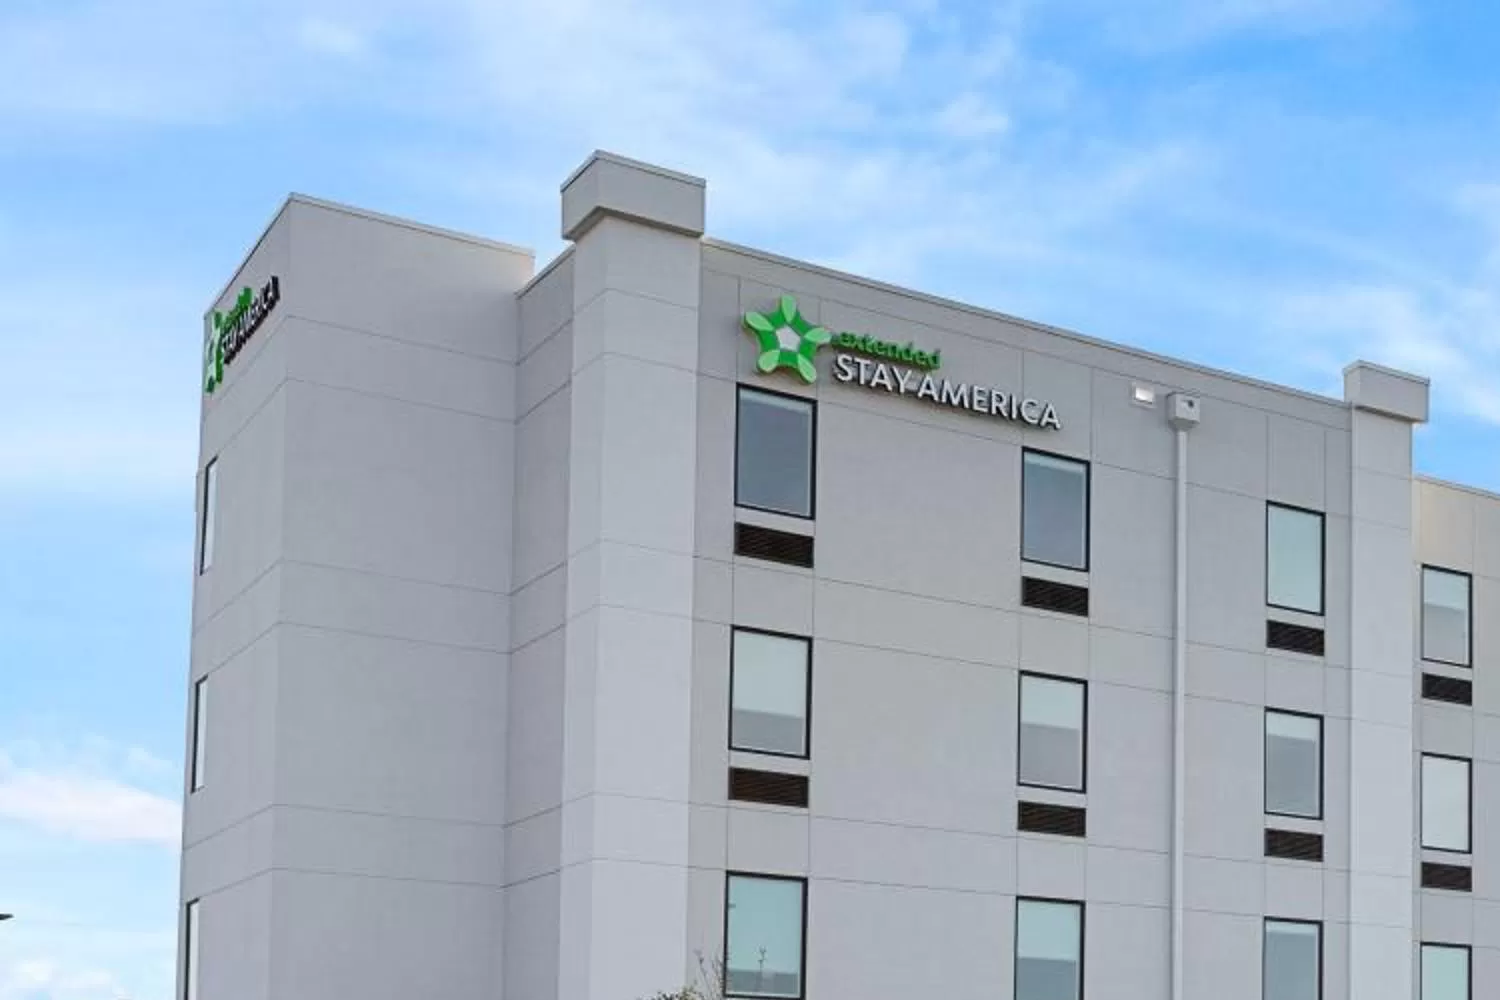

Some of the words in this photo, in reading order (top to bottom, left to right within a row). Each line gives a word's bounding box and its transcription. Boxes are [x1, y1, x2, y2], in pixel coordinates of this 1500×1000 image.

[838, 331, 941, 369] extended
[836, 353, 912, 393] STAY
[917, 373, 1061, 429] AMERICA
